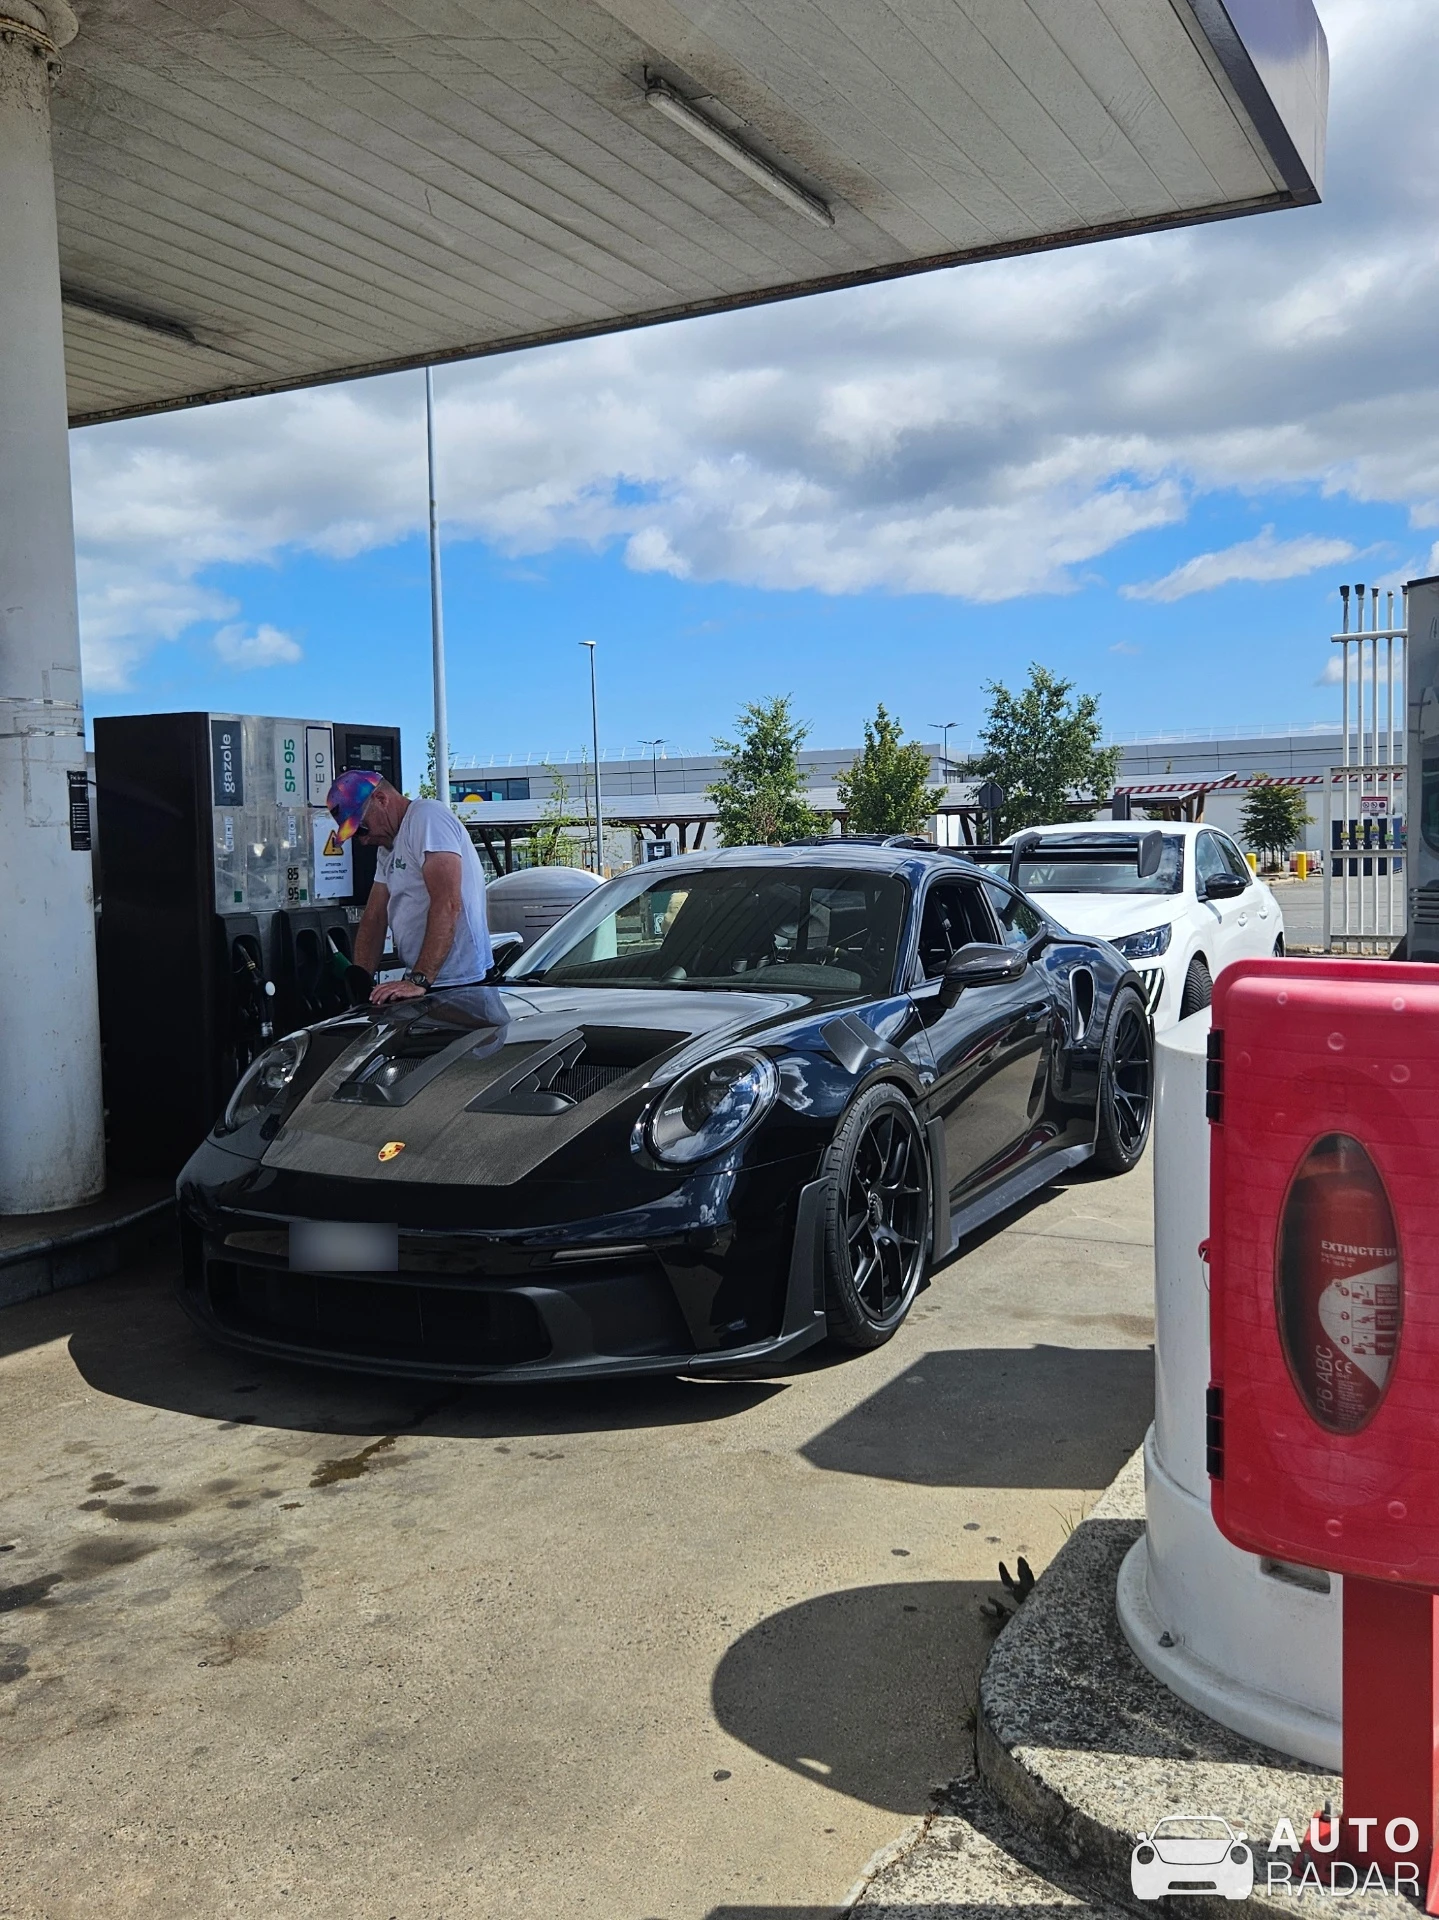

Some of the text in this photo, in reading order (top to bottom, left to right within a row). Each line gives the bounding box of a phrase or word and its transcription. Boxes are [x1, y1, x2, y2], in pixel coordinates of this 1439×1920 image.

[220, 733, 236, 793] gazole
[283, 738, 296, 793] SP 95
[315, 773, 325, 783] E
[287, 867, 300, 881] 85
[287, 886, 300, 901] 95
[1315, 1344, 1334, 1386] ABC
